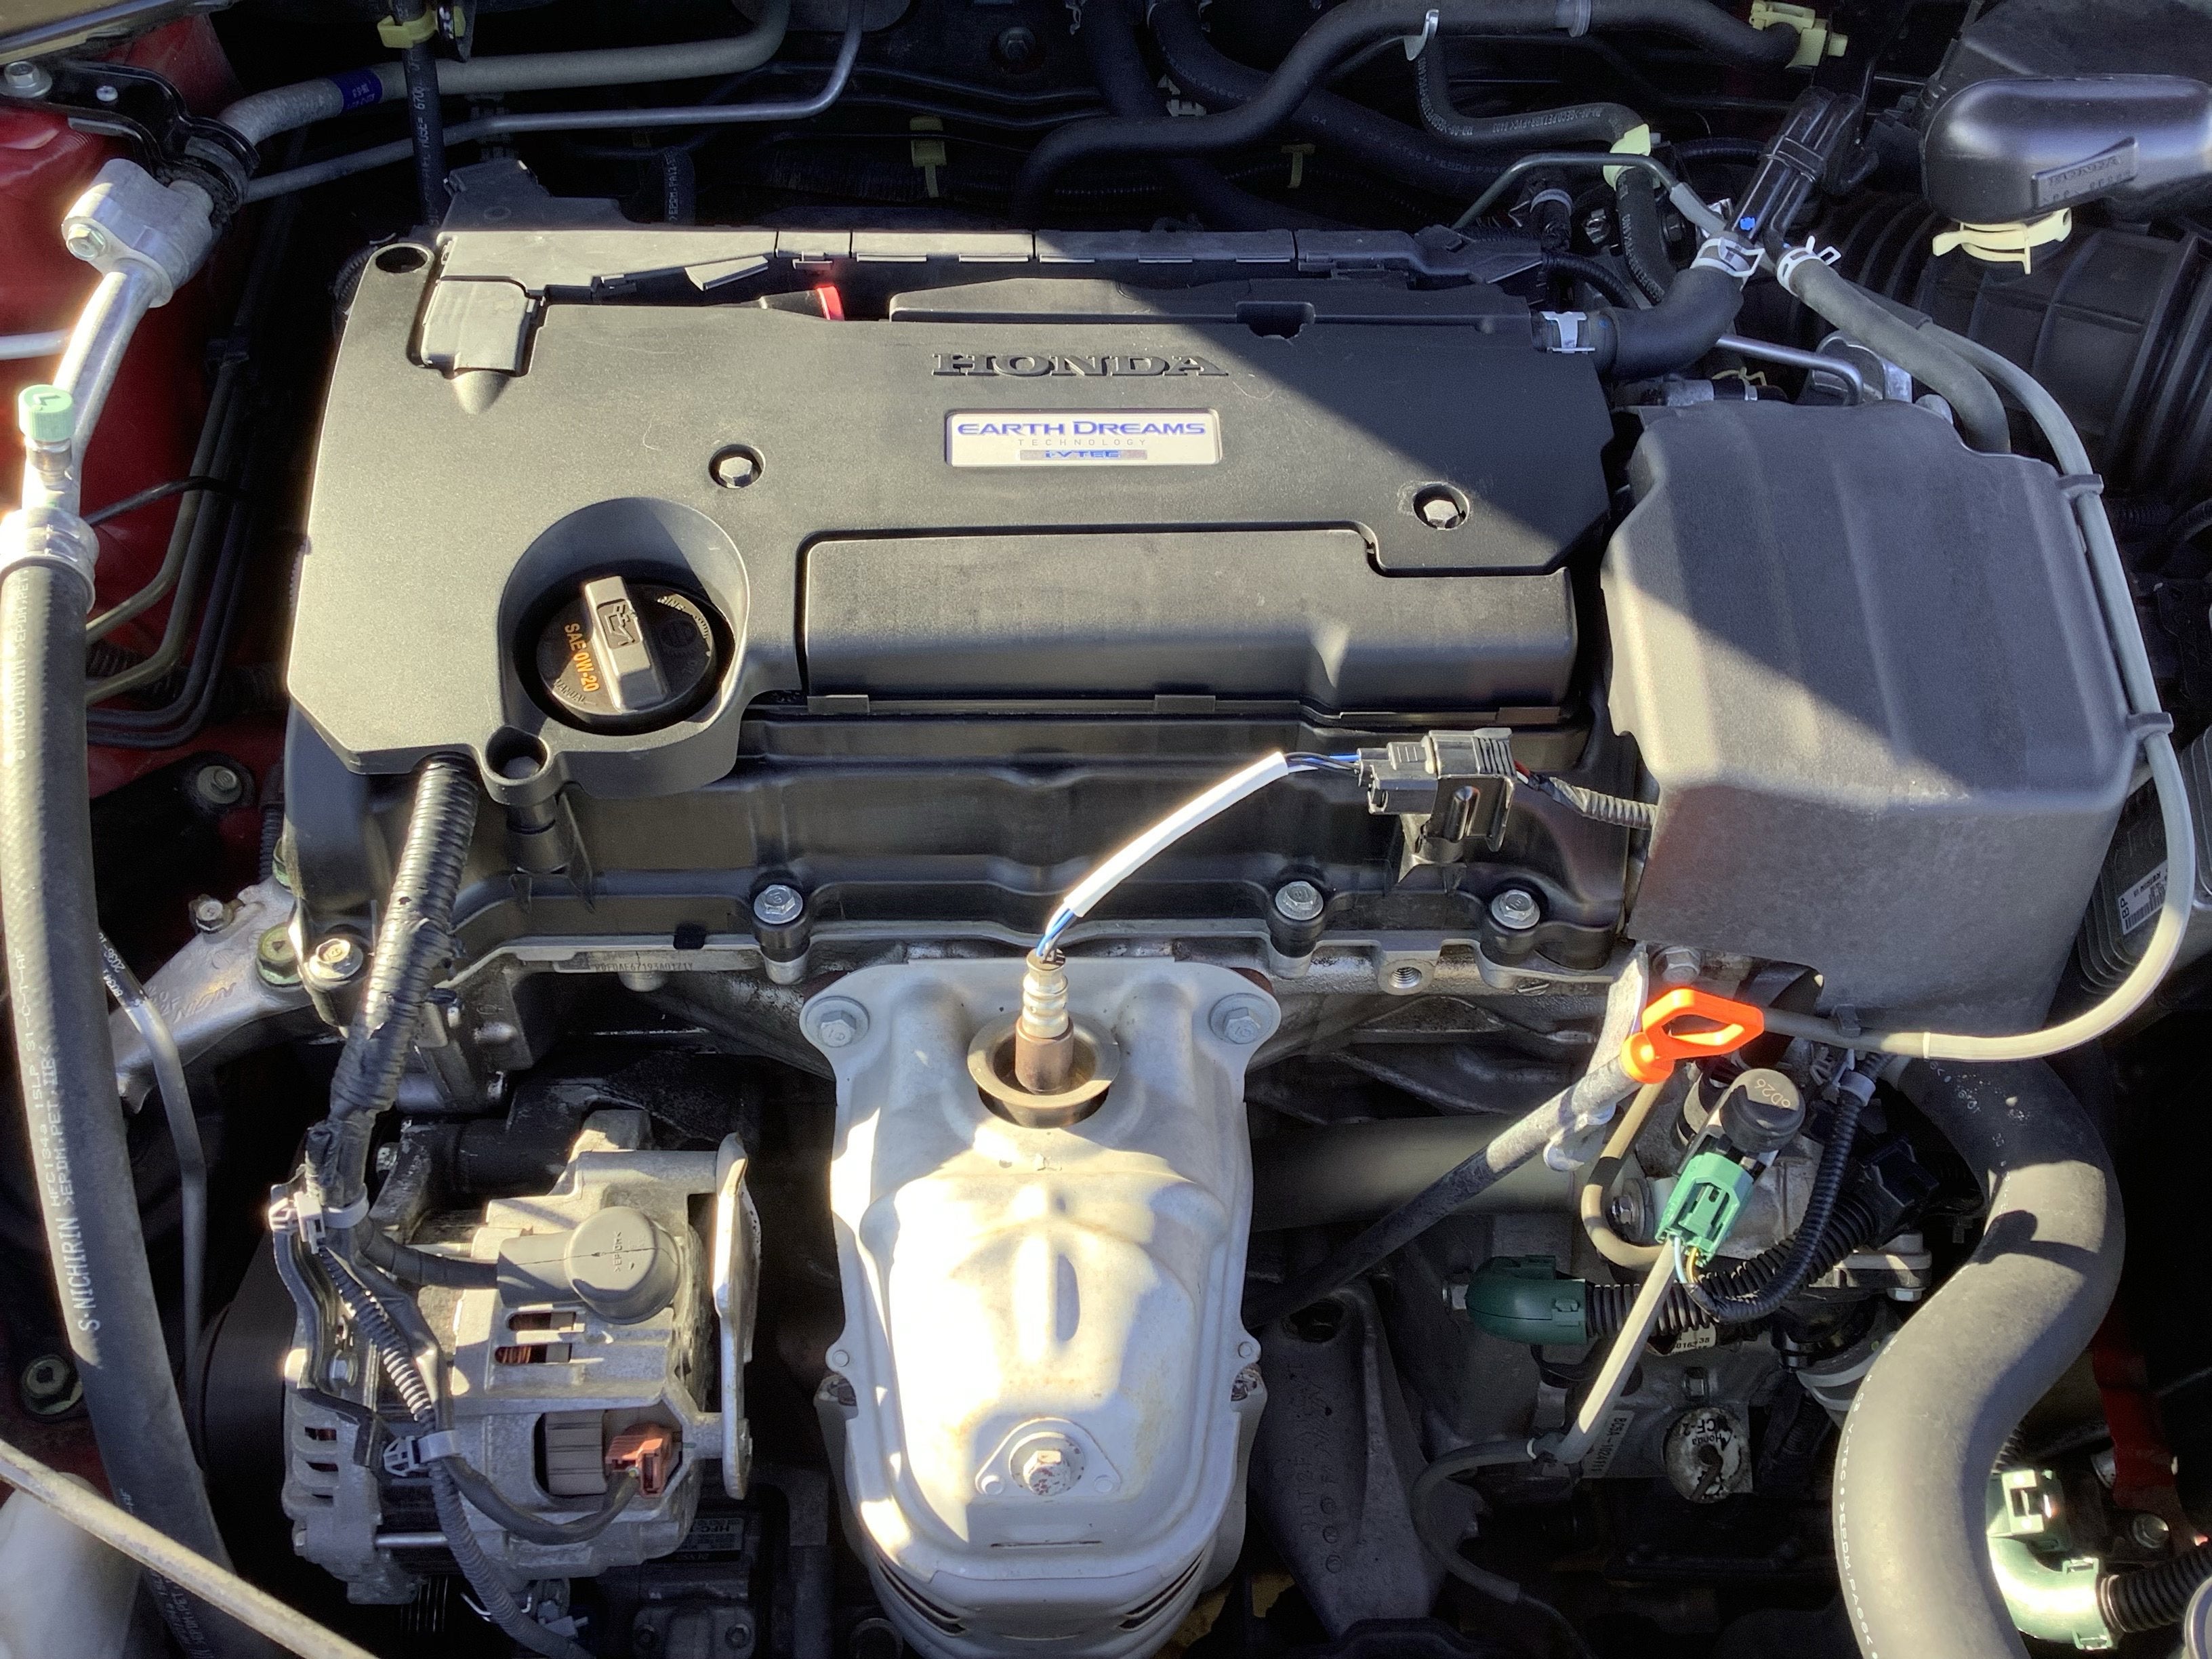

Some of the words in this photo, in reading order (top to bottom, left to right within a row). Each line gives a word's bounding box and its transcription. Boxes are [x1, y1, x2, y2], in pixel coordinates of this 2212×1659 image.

[932, 354, 1229, 376] HONDA
[957, 422, 1066, 436] EARTH
[1072, 420, 1206, 436] DREAMS
[565, 623, 586, 652] SAE
[573, 650, 600, 693] 0W-20
